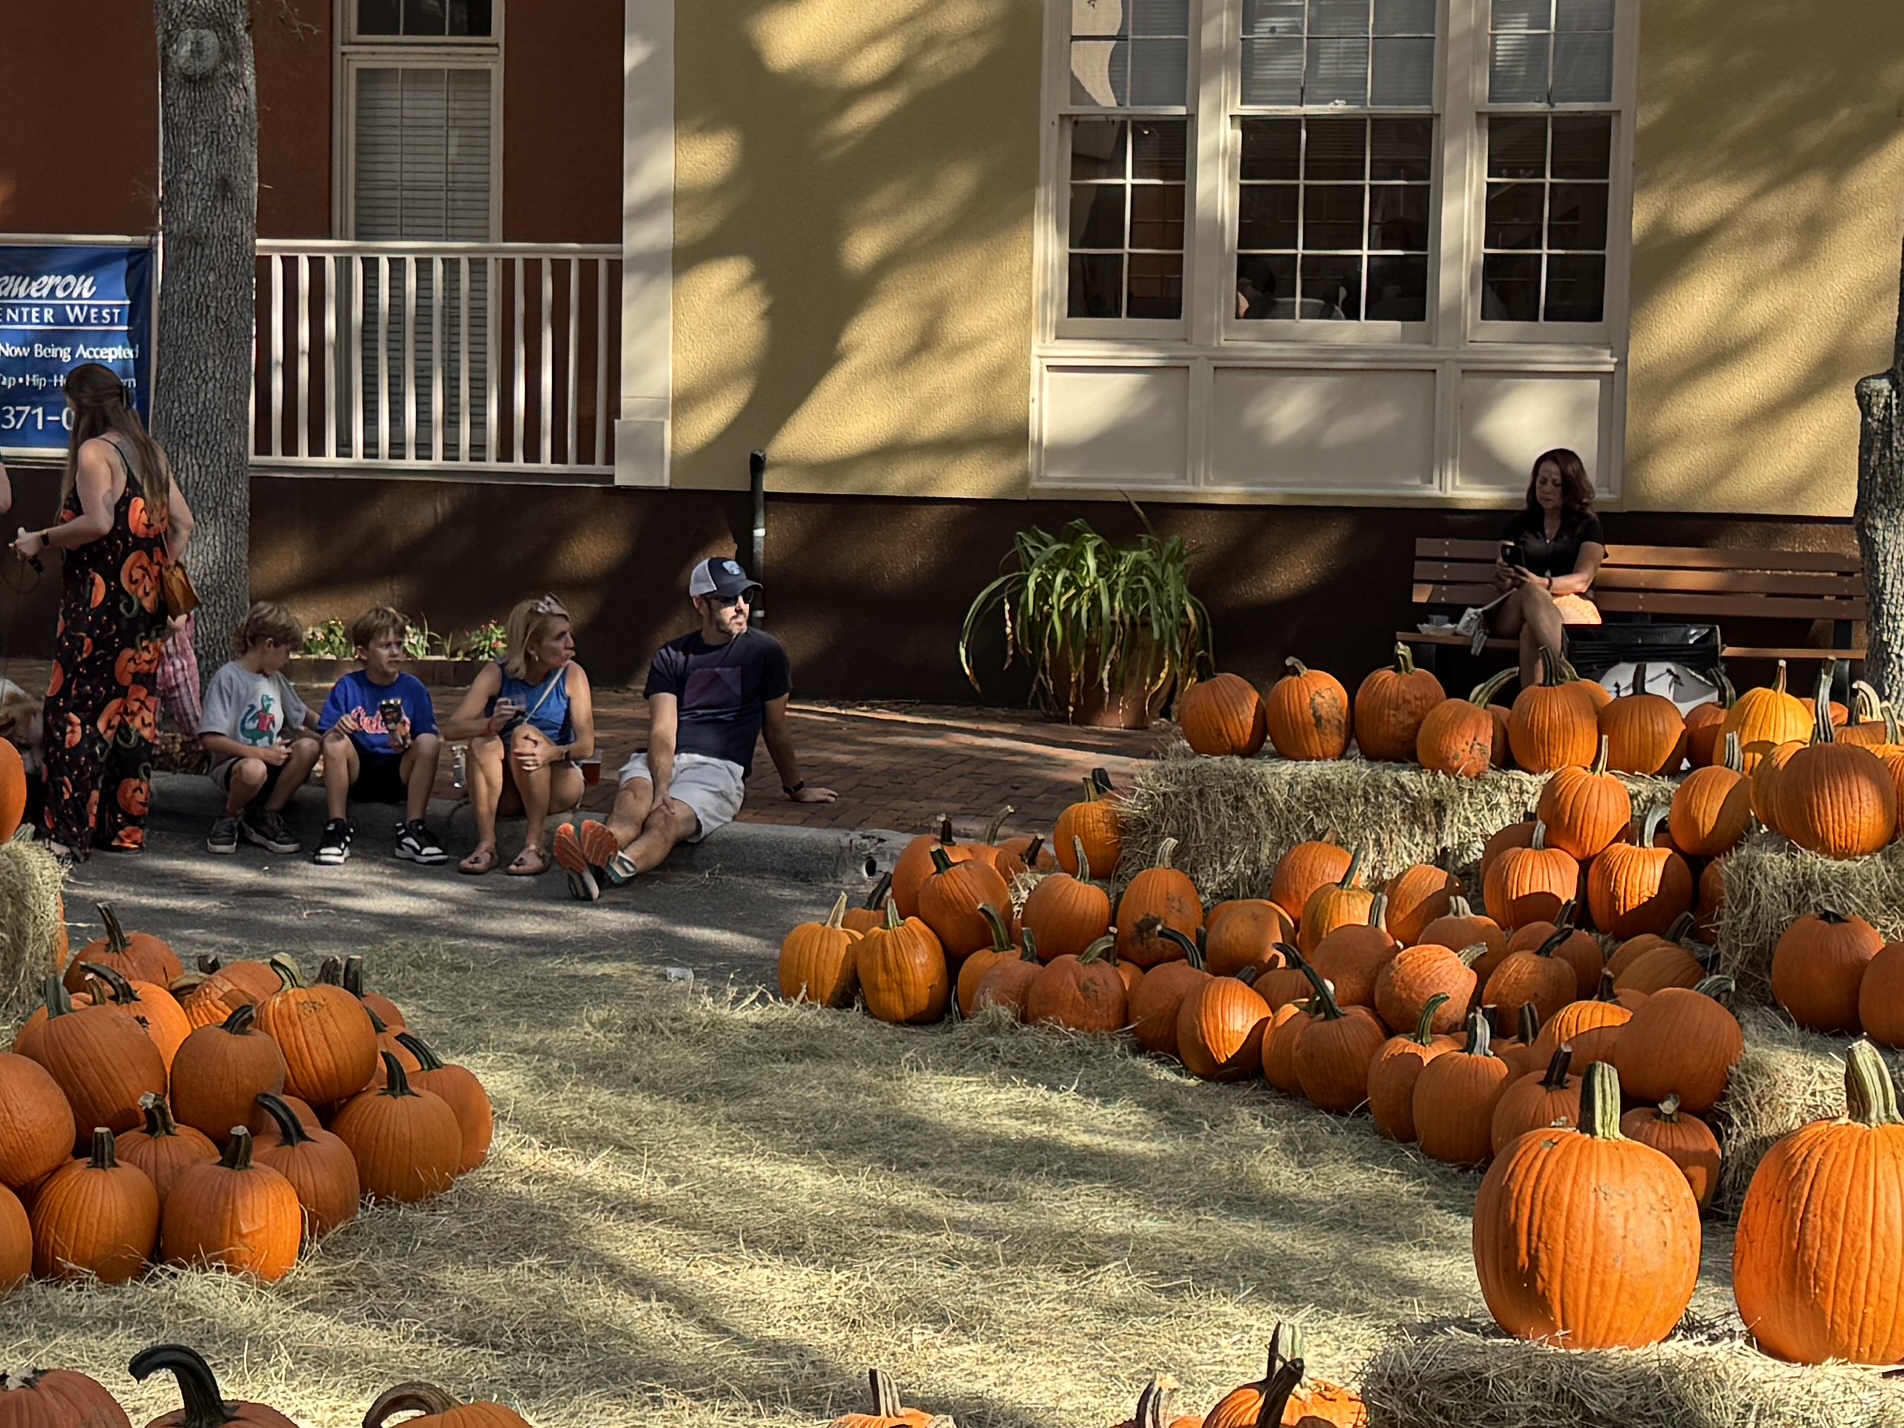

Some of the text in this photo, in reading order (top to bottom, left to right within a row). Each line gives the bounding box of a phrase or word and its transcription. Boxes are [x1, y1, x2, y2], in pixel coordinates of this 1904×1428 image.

[65, 305, 122, 325] WEST
[34, 343, 72, 363] Being
[75, 344, 140, 364] Accepted
